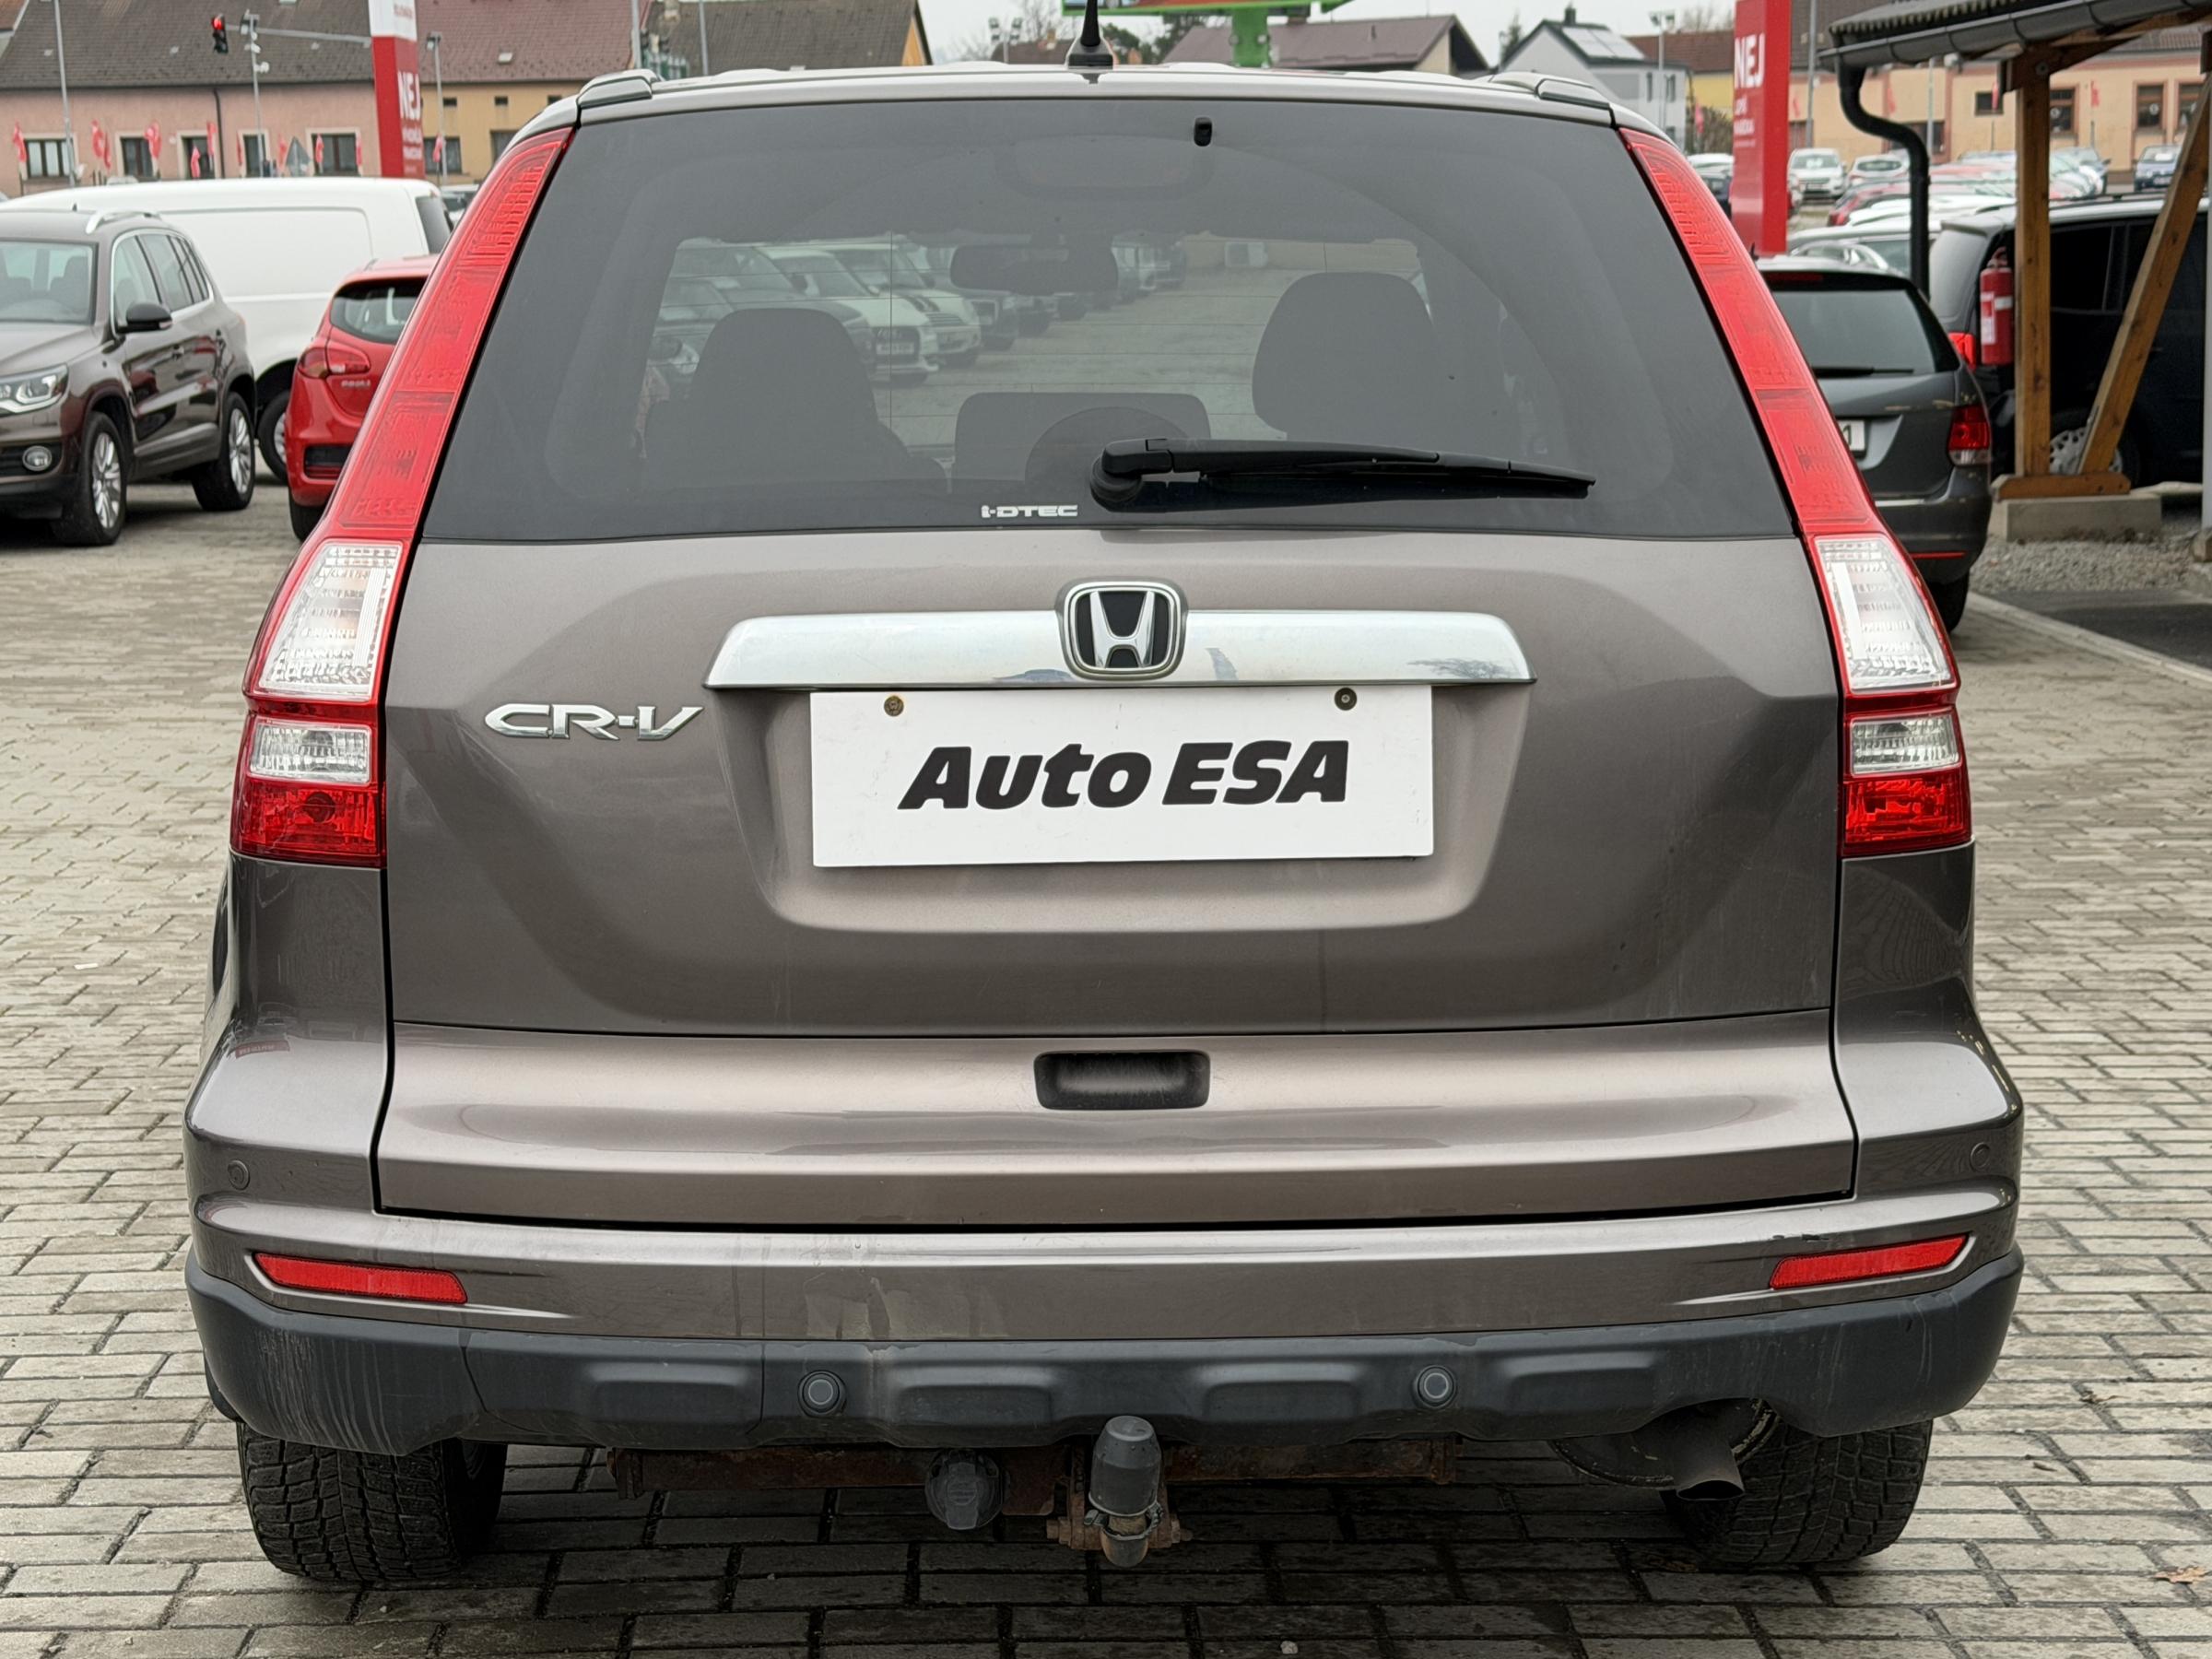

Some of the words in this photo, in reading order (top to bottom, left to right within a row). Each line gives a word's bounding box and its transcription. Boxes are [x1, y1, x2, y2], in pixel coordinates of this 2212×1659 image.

[1735, 32, 1765, 88] NEJ
[485, 703, 704, 741] CR-V
[897, 743, 1151, 810] Auto
[1161, 740, 1349, 806] ESA
